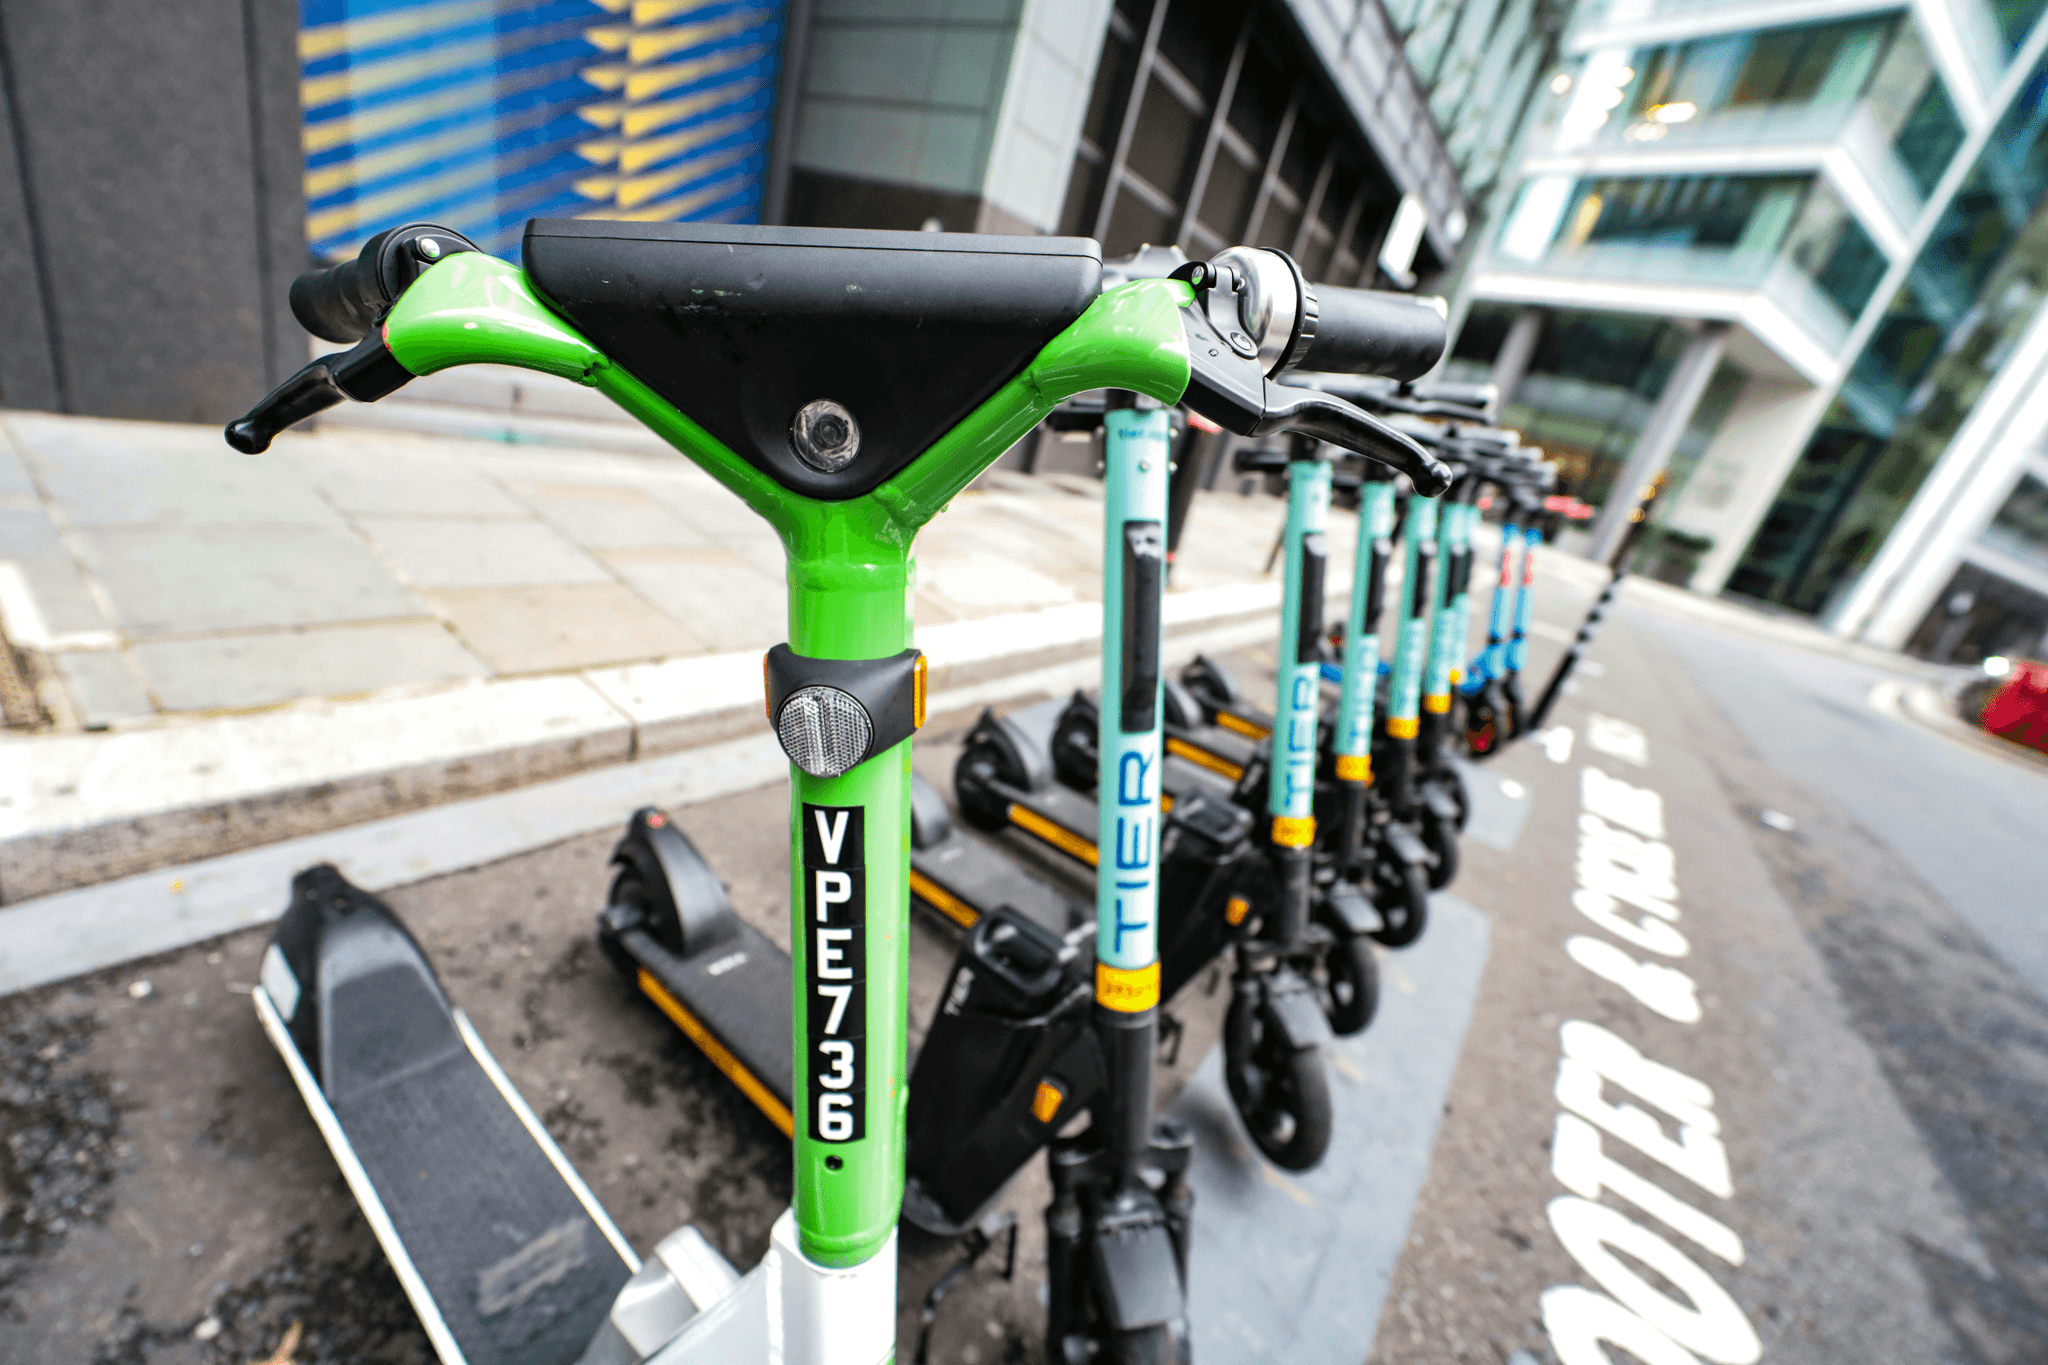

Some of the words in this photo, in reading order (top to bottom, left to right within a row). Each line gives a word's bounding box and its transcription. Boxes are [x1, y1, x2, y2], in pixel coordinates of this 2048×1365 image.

[1284, 675, 1314, 808] TIER
[1114, 751, 1153, 954] TIER
[814, 809, 855, 1142] VPE736
